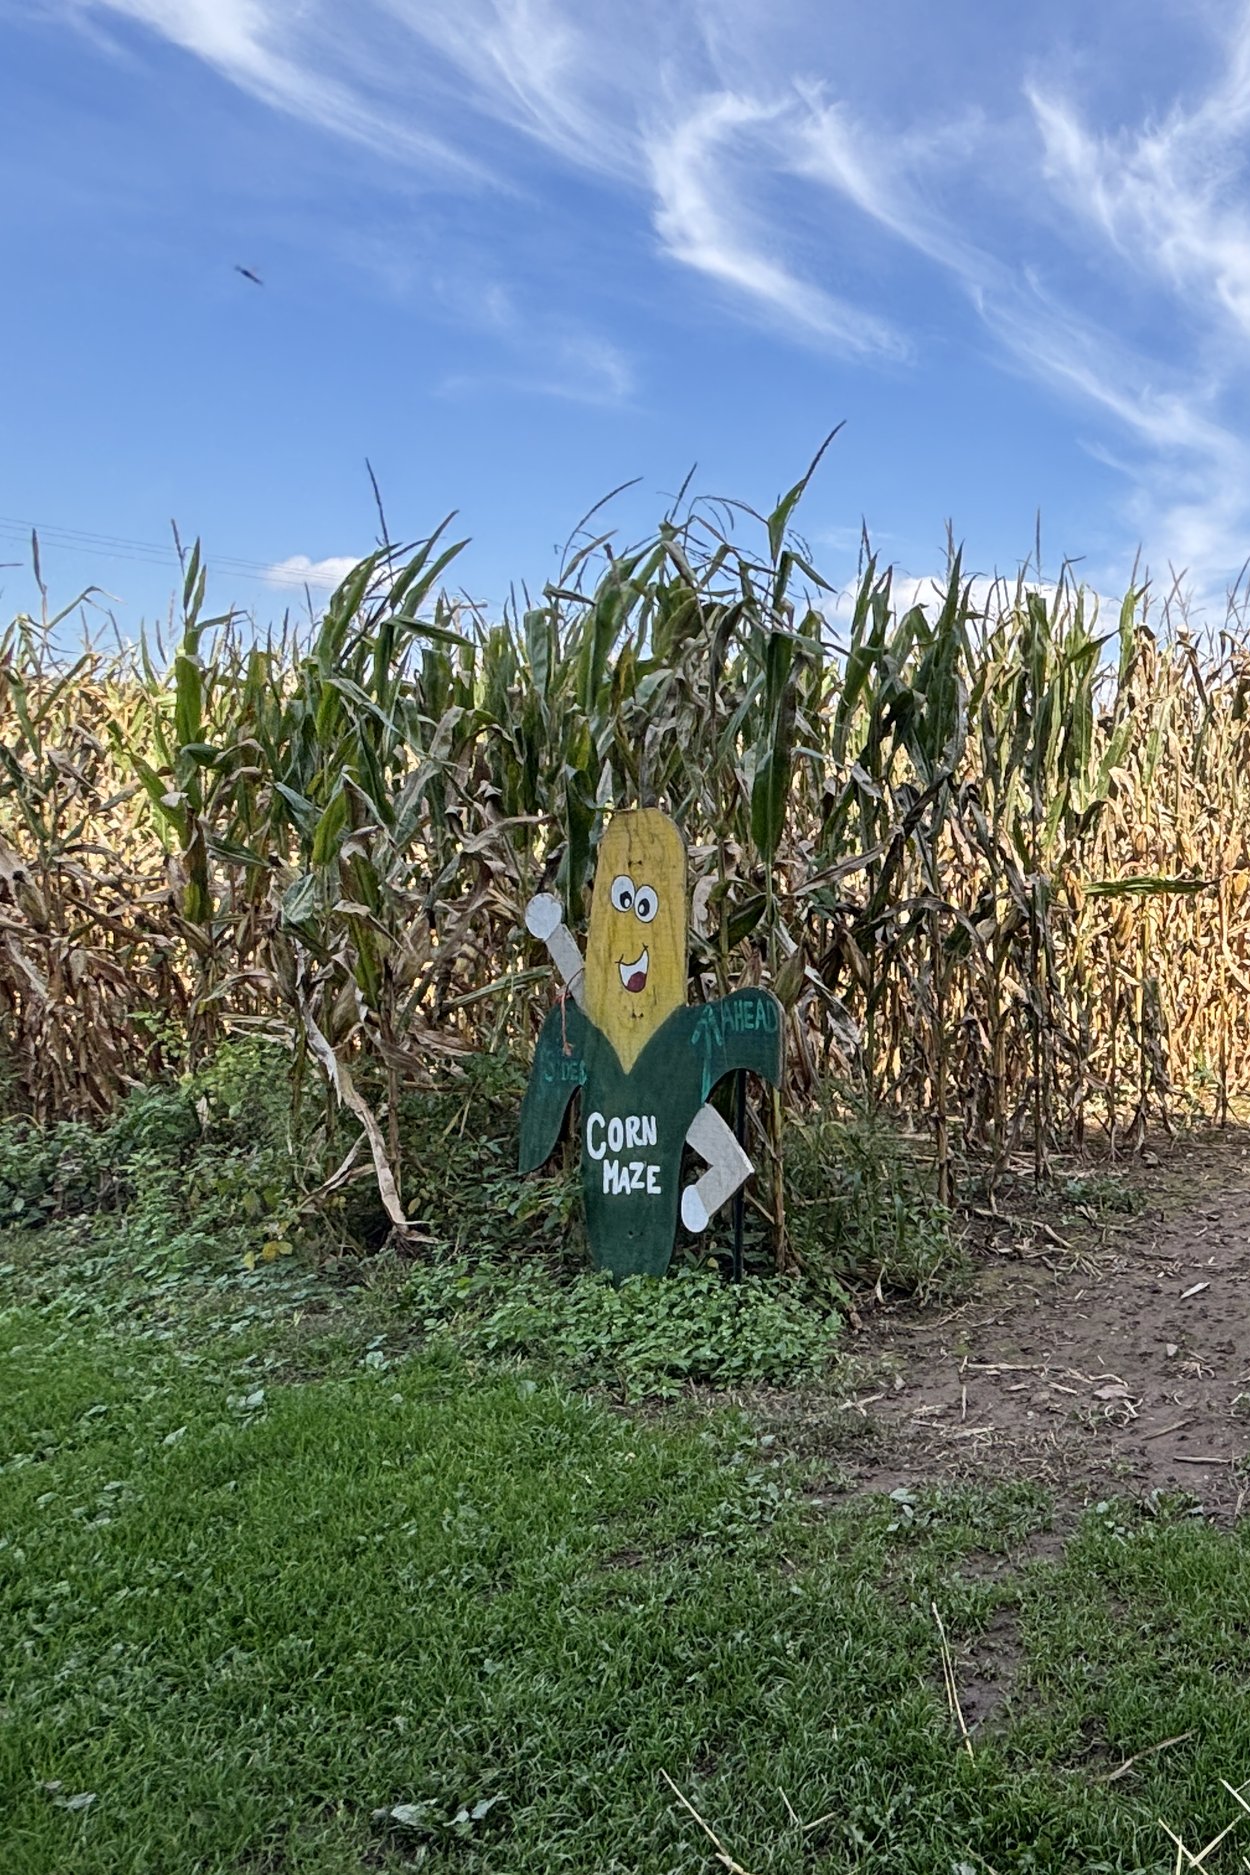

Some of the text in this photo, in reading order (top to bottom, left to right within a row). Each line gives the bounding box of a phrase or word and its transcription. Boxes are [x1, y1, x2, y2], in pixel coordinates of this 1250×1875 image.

[721, 998, 778, 1034] AHEAD
[587, 1112, 657, 1160] CORN
[603, 1159, 662, 1195] MAZE
